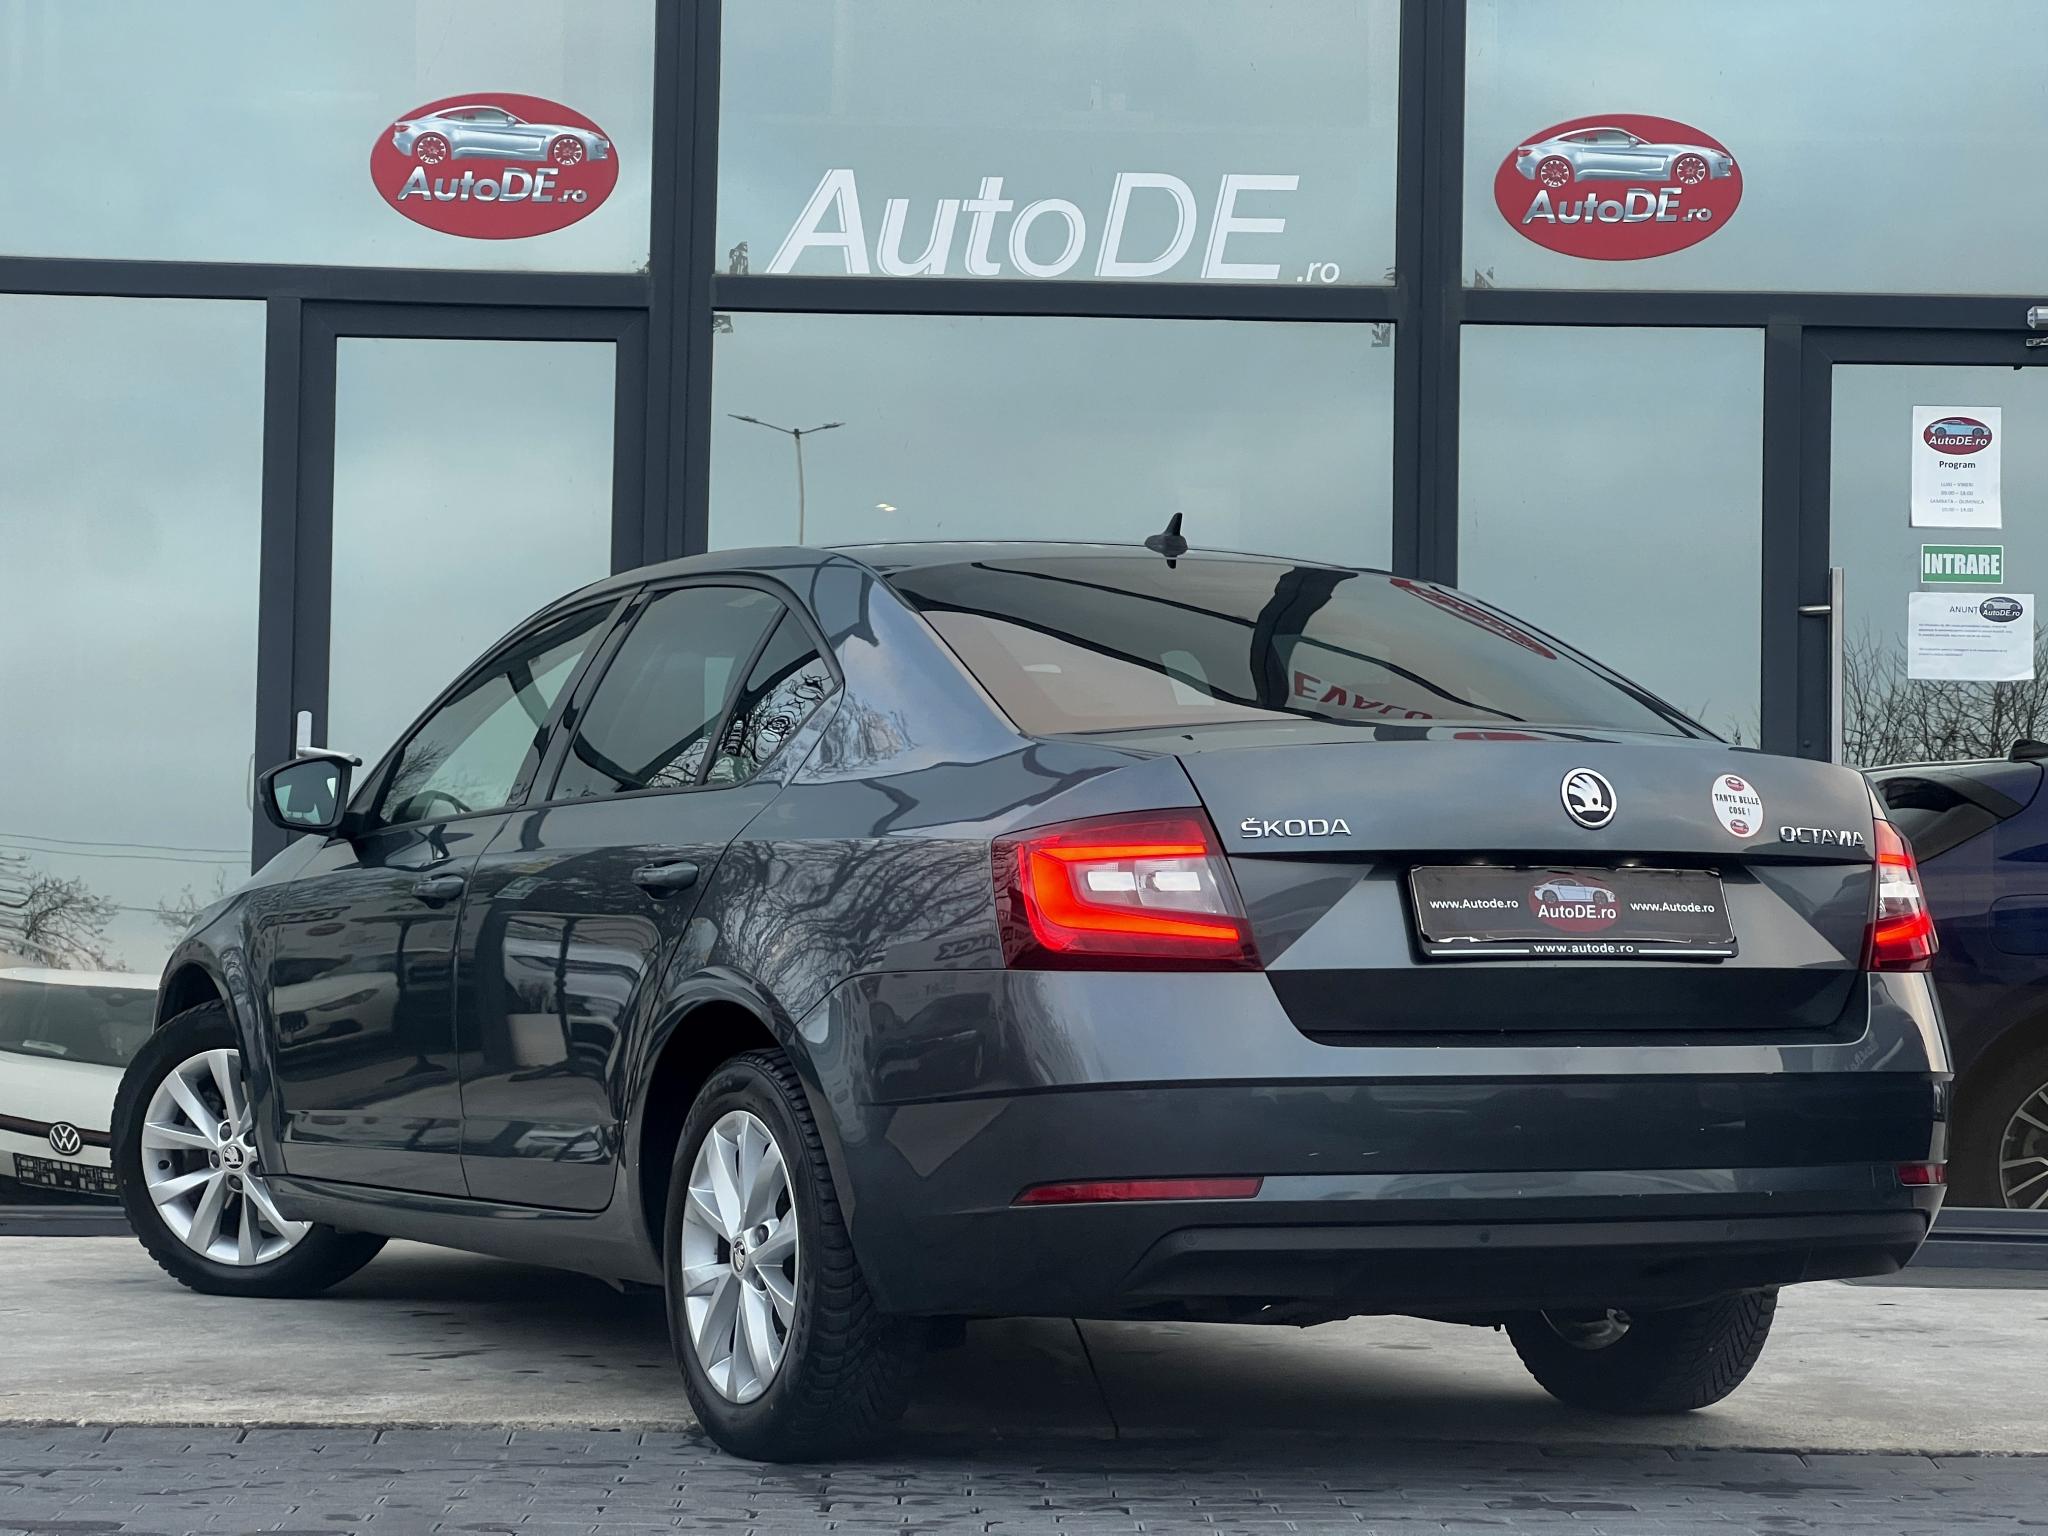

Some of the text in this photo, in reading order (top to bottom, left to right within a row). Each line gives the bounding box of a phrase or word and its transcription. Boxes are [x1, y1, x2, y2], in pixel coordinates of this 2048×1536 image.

[1928, 435, 1988, 447] AutoDE.ro
[1939, 460, 1976, 470] Program
[1924, 553, 2001, 576] INTRARE
[1714, 793, 1760, 805] TANTE BELLE
[1728, 806, 1746, 815] COSE
[1241, 817, 1352, 838] ŠKODA
[1779, 826, 1865, 847] OCTAVIA
[1429, 898, 1519, 909] www.Autode.ro
[1630, 901, 1715, 913] www.Autode.ro
[1537, 904, 1617, 920] AutoDE.ro
[1533, 943, 1634, 954] www.autode.ro
